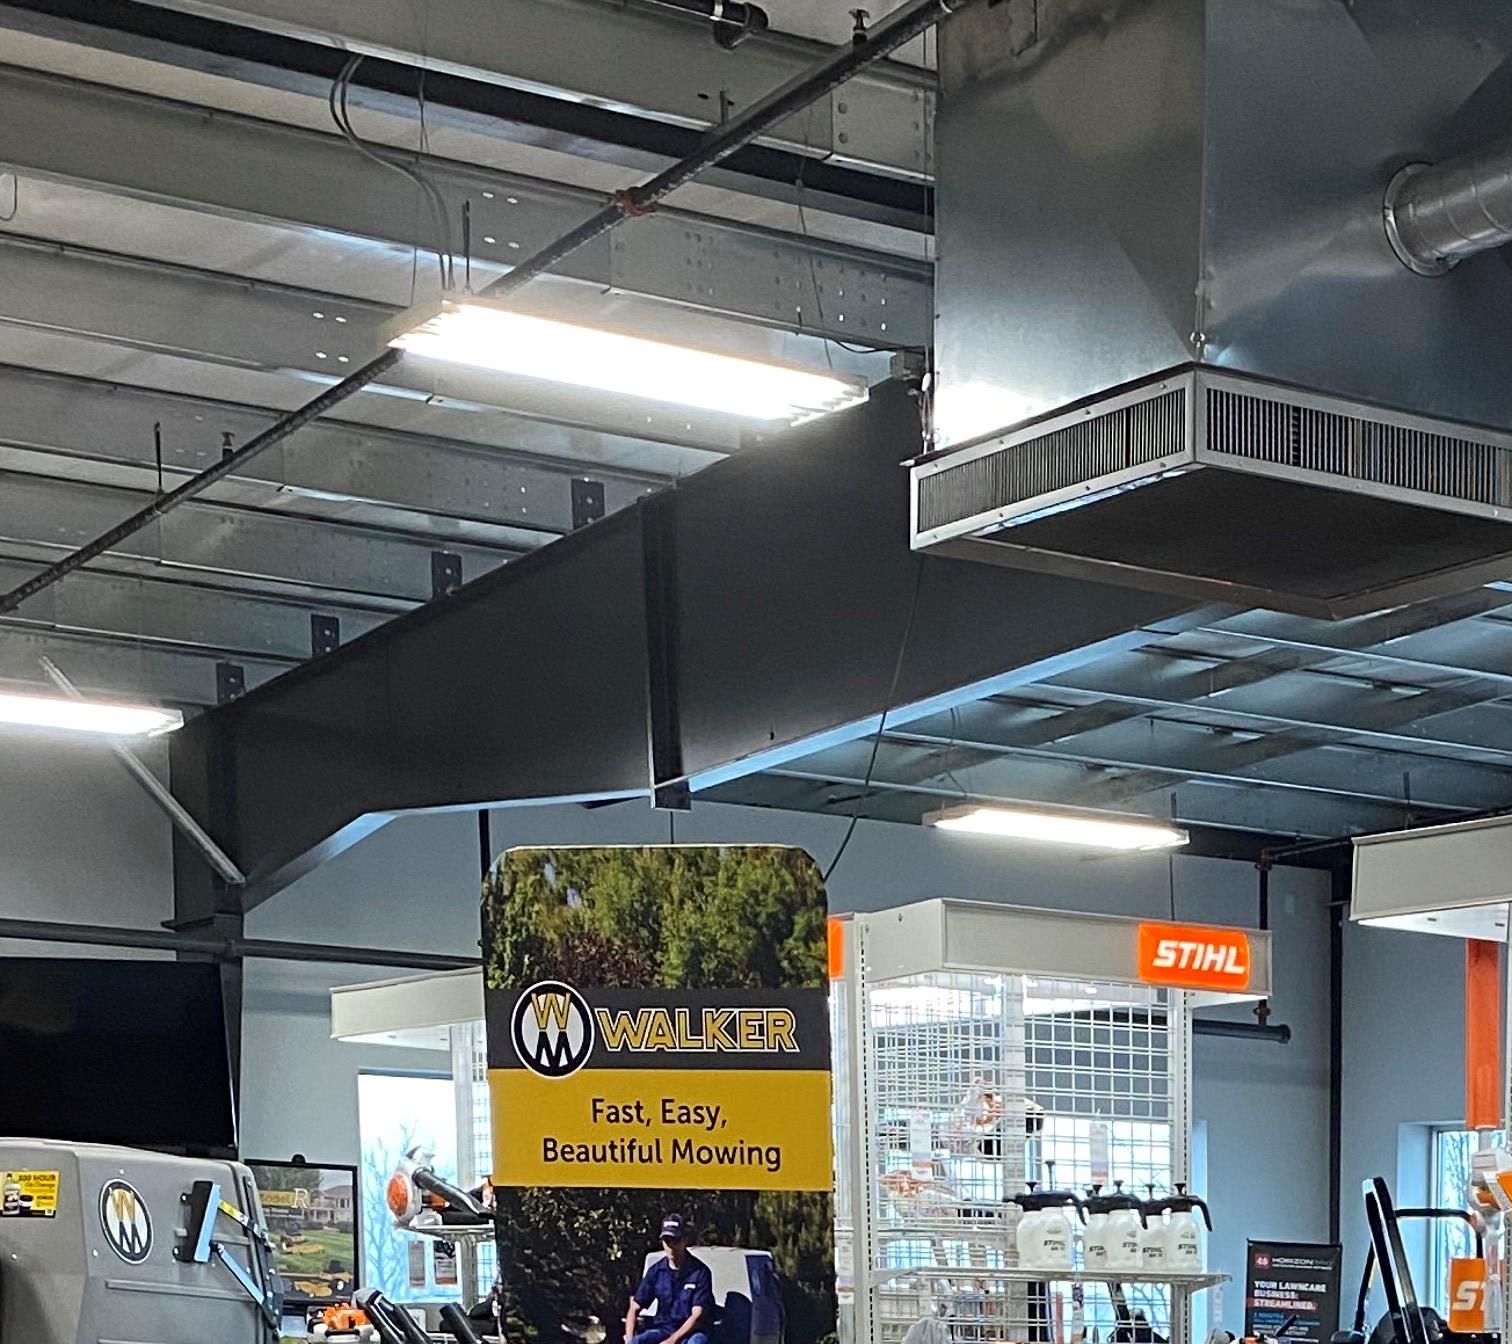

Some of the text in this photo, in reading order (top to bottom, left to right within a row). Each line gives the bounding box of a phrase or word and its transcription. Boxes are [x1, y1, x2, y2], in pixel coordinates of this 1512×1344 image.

[1152, 939, 1246, 975] STIHL
[594, 1007, 801, 1054] WALKER
[591, 1098, 728, 1131] Fast, Easy,
[543, 1138, 781, 1173] Beautiful Mowing
[1253, 1281, 1327, 1293] YOUR LAWNCARE
